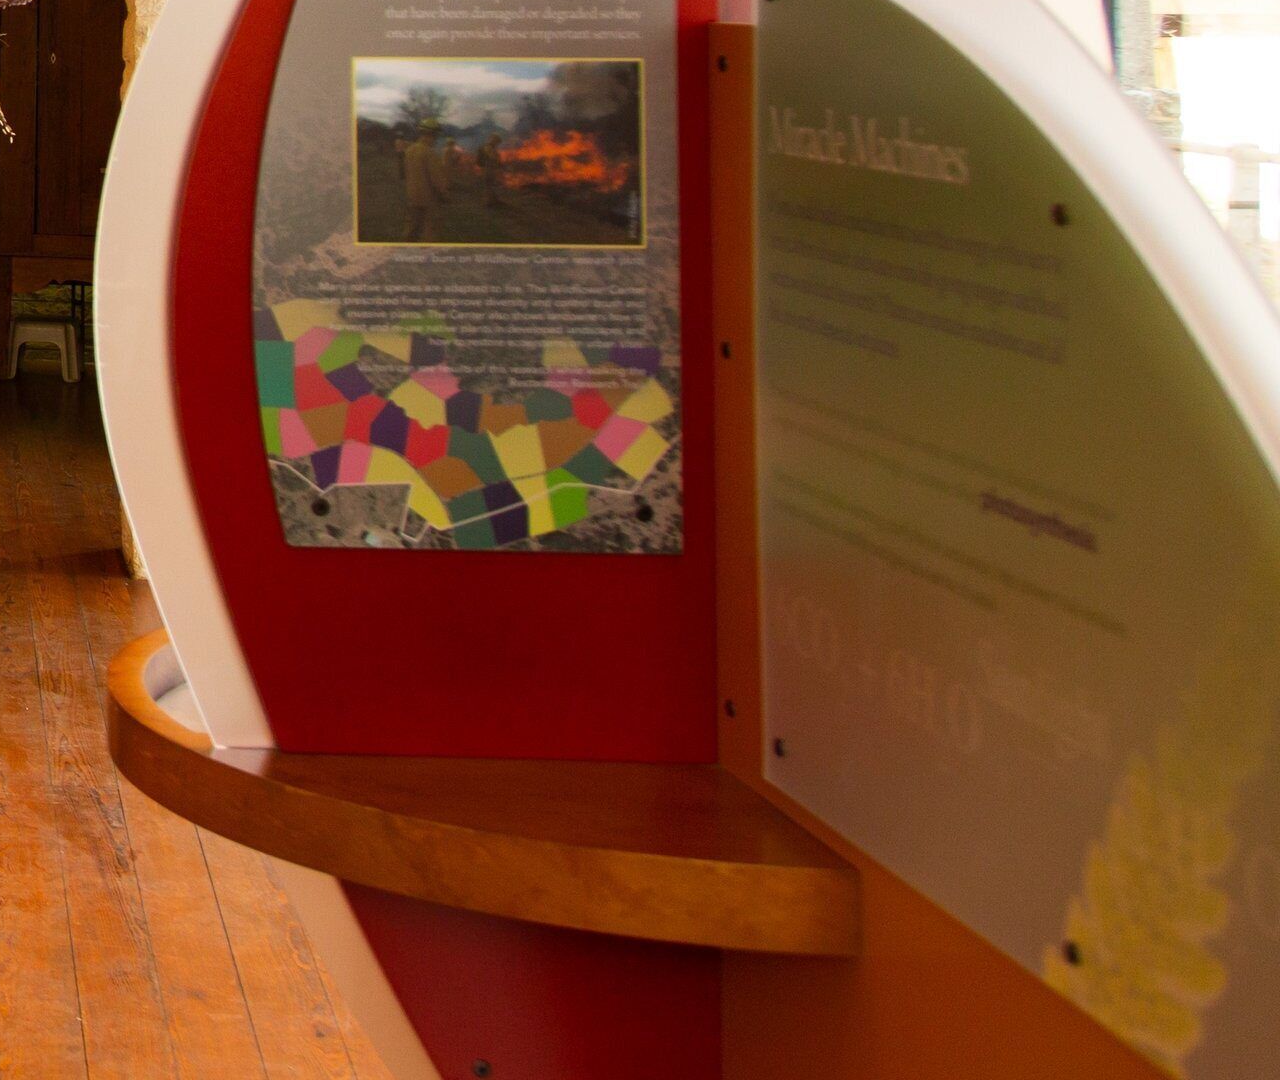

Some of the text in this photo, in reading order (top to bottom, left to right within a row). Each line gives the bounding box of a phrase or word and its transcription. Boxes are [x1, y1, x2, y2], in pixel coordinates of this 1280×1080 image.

[449, 27, 494, 43] provide
[766, 106, 969, 186] Miracle Machines
